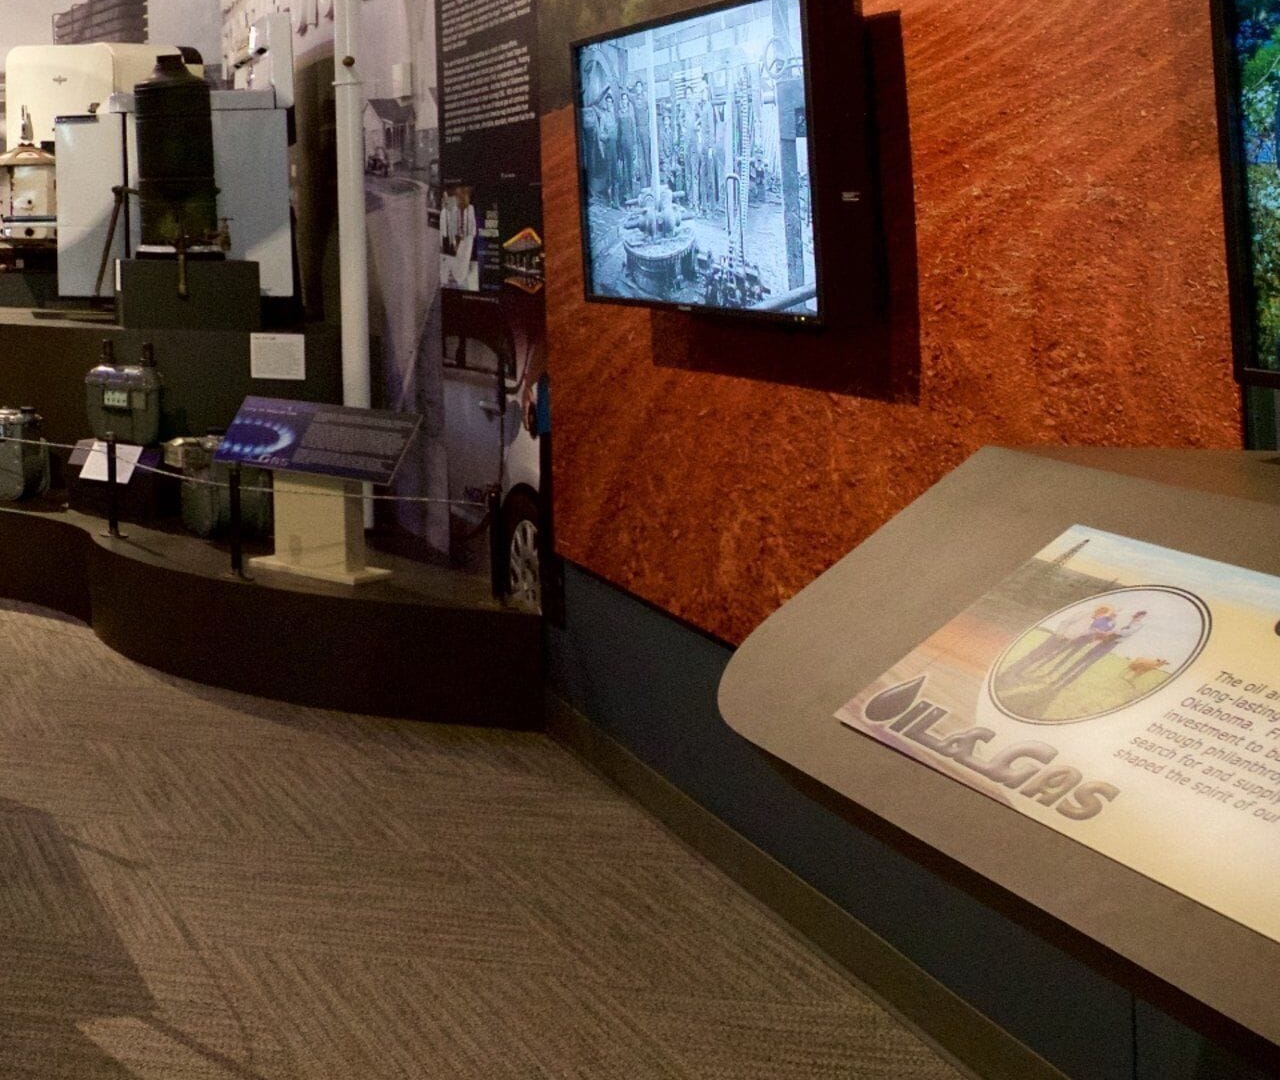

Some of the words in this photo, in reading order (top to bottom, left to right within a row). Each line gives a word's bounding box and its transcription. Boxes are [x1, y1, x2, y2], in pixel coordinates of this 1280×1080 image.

[1215, 671, 1243, 688] The
[1243, 682, 1268, 694] oil
[1180, 696, 1254, 732] Oklahoma.
[1196, 683, 1280, 723] long-lasting
[1146, 723, 1204, 751] through
[1163, 709, 1246, 747] investment
[1245, 740, 1264, 754] to
[1113, 748, 1166, 776] shaped
[1165, 769, 1190, 786] the
[1190, 779, 1234, 804] spirit
[1232, 798, 1256, 813] of
[1129, 735, 1177, 762] search
[1178, 754, 1202, 769] for
[1202, 764, 1234, 783] and
[1233, 777, 1280, 805] supply
